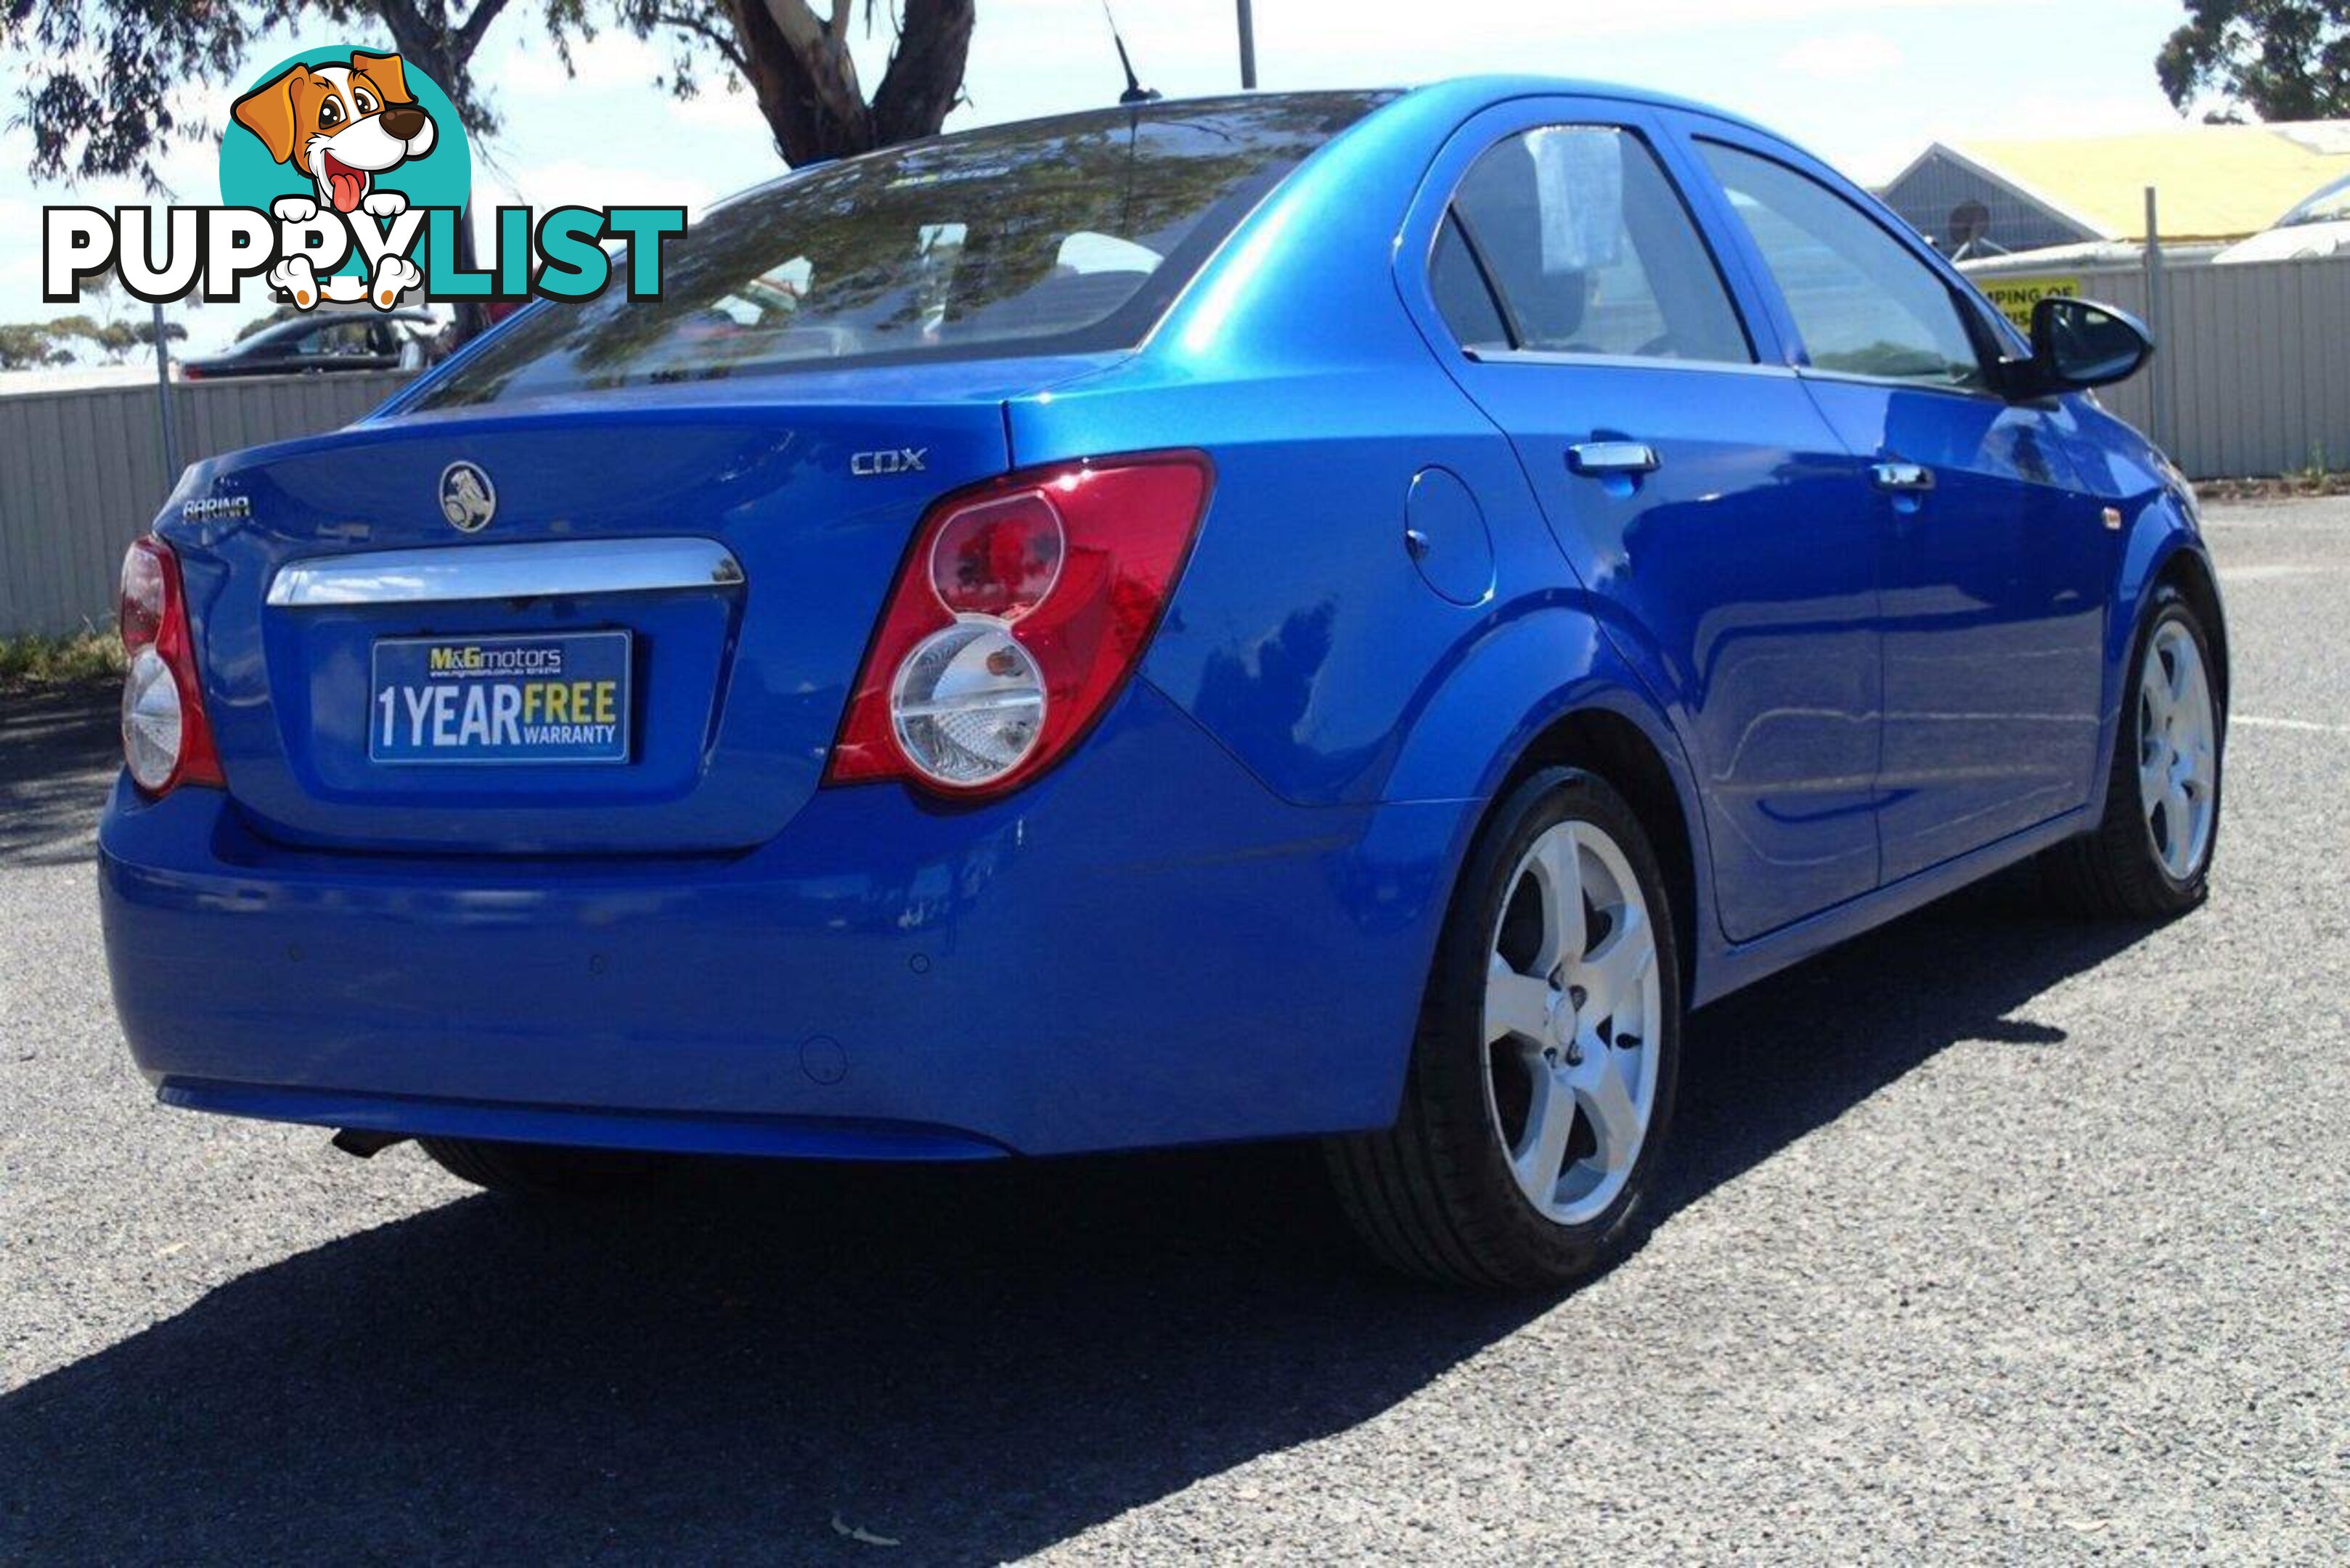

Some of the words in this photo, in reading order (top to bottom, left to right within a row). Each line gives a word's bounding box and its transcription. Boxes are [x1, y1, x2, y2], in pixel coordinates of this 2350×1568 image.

[851, 447, 928, 475] CDX
[379, 687, 394, 746] 1
[403, 684, 521, 747] YEAR
[523, 682, 616, 724] FREE
[523, 724, 616, 745] WARRANTY
